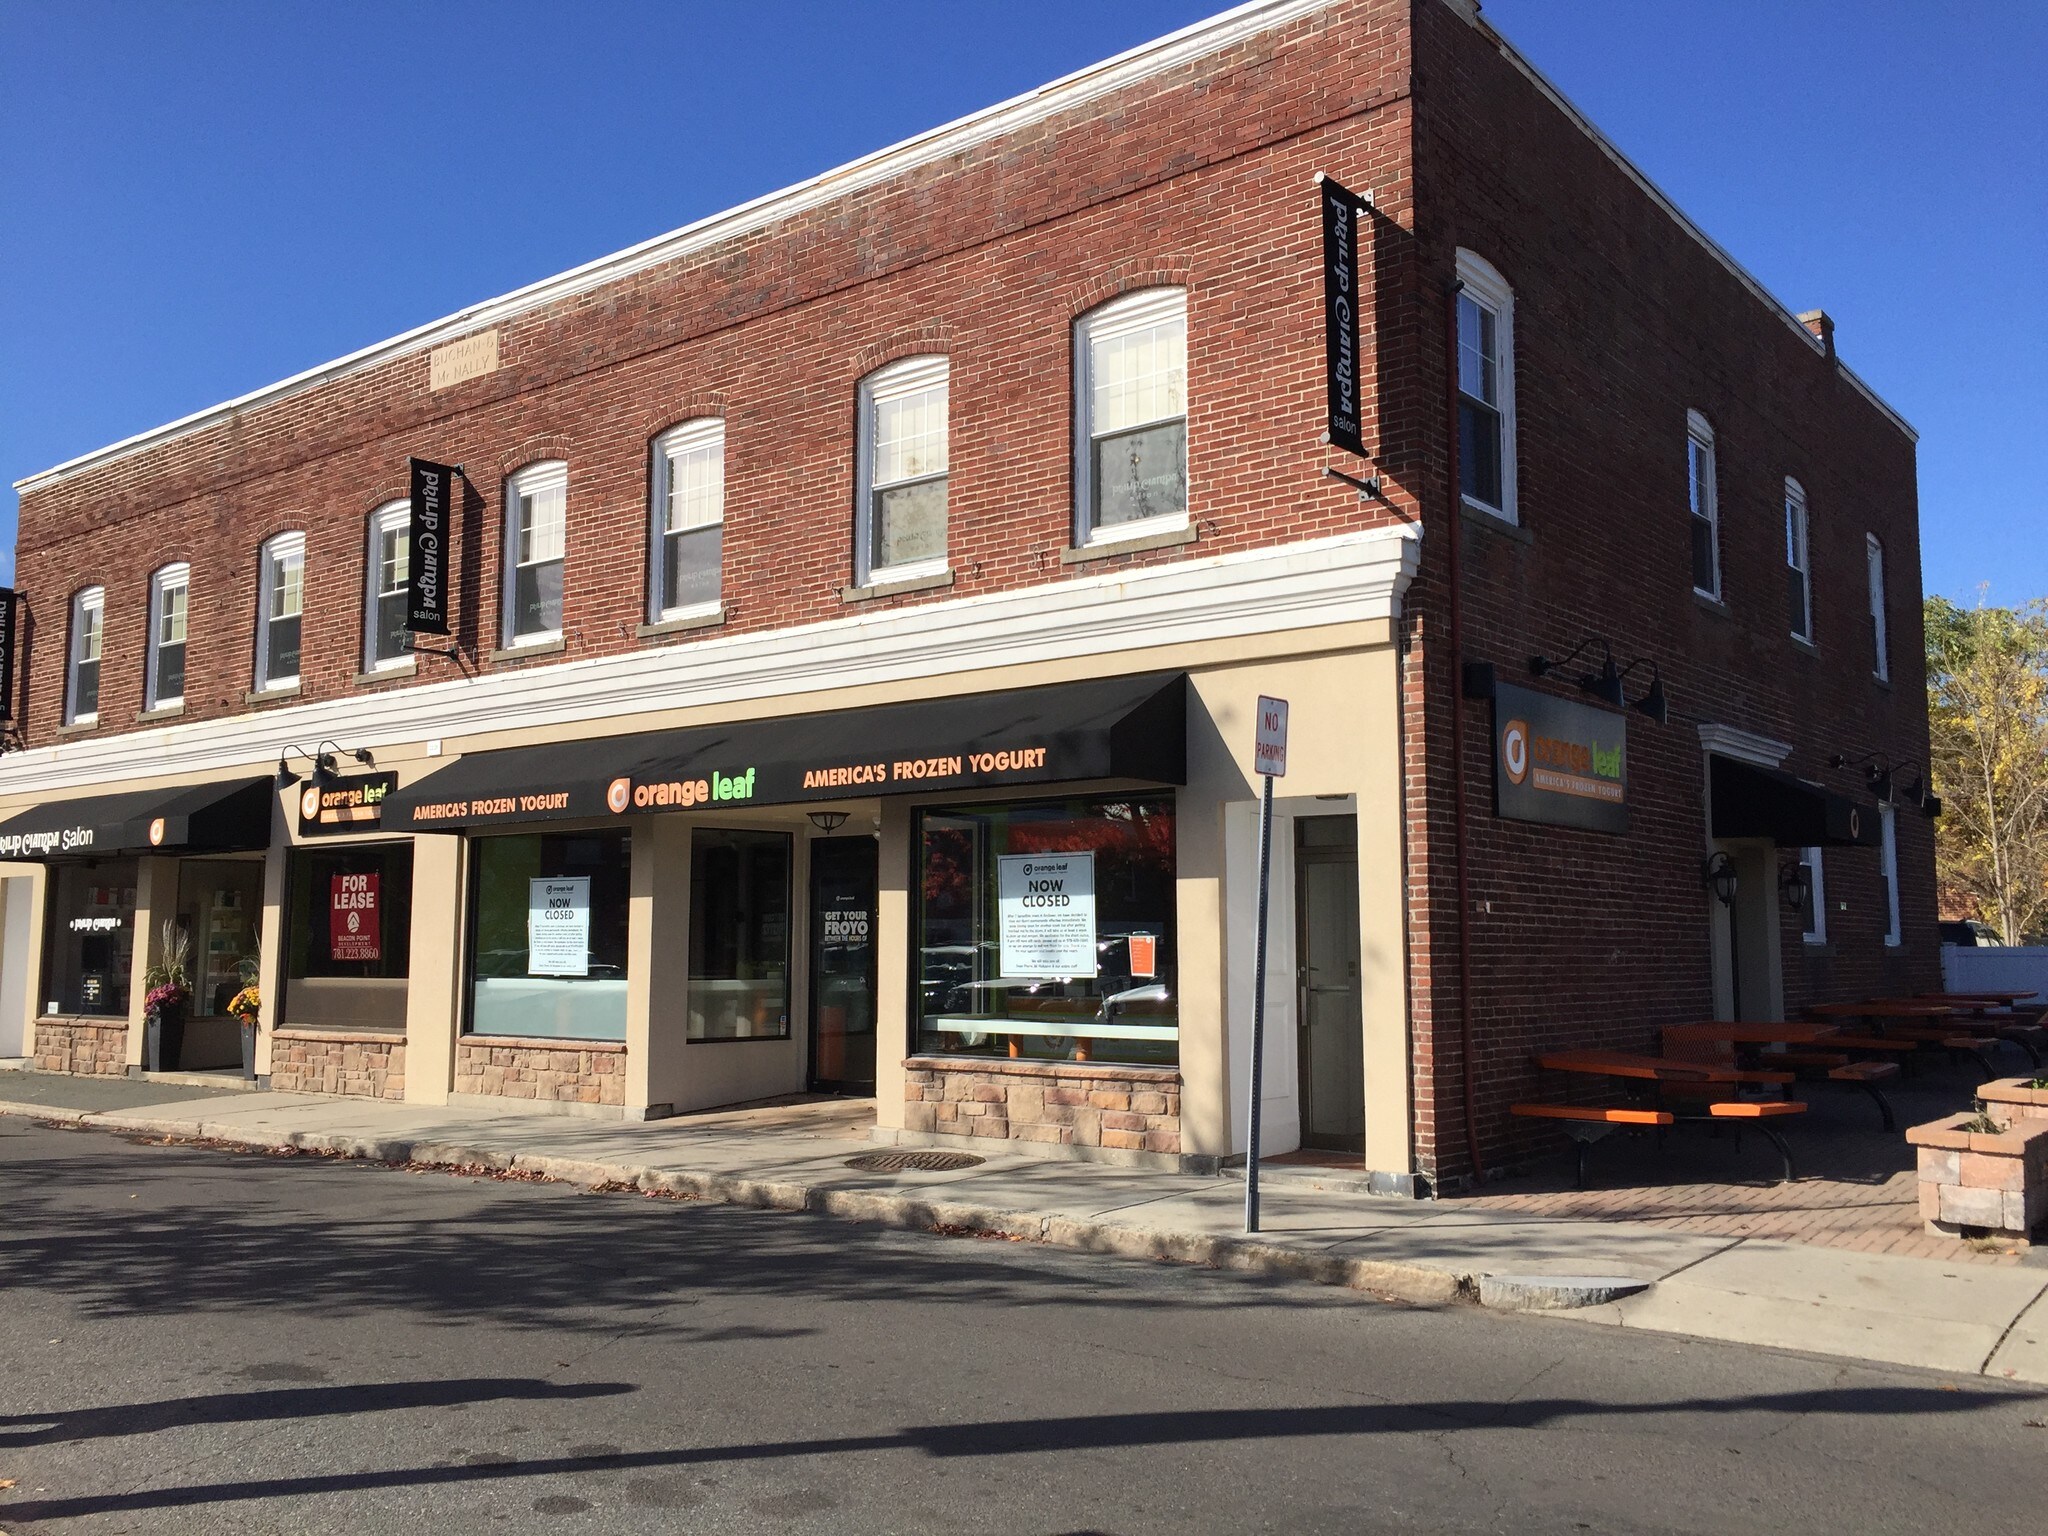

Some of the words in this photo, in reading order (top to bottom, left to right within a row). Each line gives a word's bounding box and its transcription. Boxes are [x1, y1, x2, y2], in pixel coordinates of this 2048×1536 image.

[1333, 414, 1357, 436] salon
[413, 610, 440, 622] salon
[1265, 712, 1279, 732] NO
[1257, 742, 1284, 762] PARKING
[1534, 736, 1590, 772] orange
[1592, 740, 1621, 778] leaf
[803, 763, 886, 789] AMERICA'S
[893, 756, 962, 780] FROZEN
[969, 748, 1046, 772] YOGURT
[321, 790, 362, 807] orange
[364, 782, 389, 803] leaf
[634, 779, 709, 807] orange
[712, 767, 757, 801] leaf
[1535, 773, 1570, 790] AMERICA'S
[1570, 780, 1596, 794] FROZEN
[1598, 785, 1621, 799] YOGURT
[413, 801, 468, 821] AMERICA'S
[471, 797, 517, 815] FROZEN
[519, 793, 569, 811] YOGURT
[62, 826, 93, 850] Salon
[1034, 864, 1055, 872] orange
[1056, 863, 1068, 871] leaf
[342, 875, 367, 892] FOR
[1029, 879, 1063, 892] NOW
[334, 892, 375, 909] LEASE
[549, 898, 571, 908] NOW
[1022, 894, 1070, 908] CLOSED
[545, 910, 574, 920] CLOSED
[825, 911, 841, 921] GET
[843, 910, 868, 920] YOUR
[825, 920, 869, 935] FROYO
